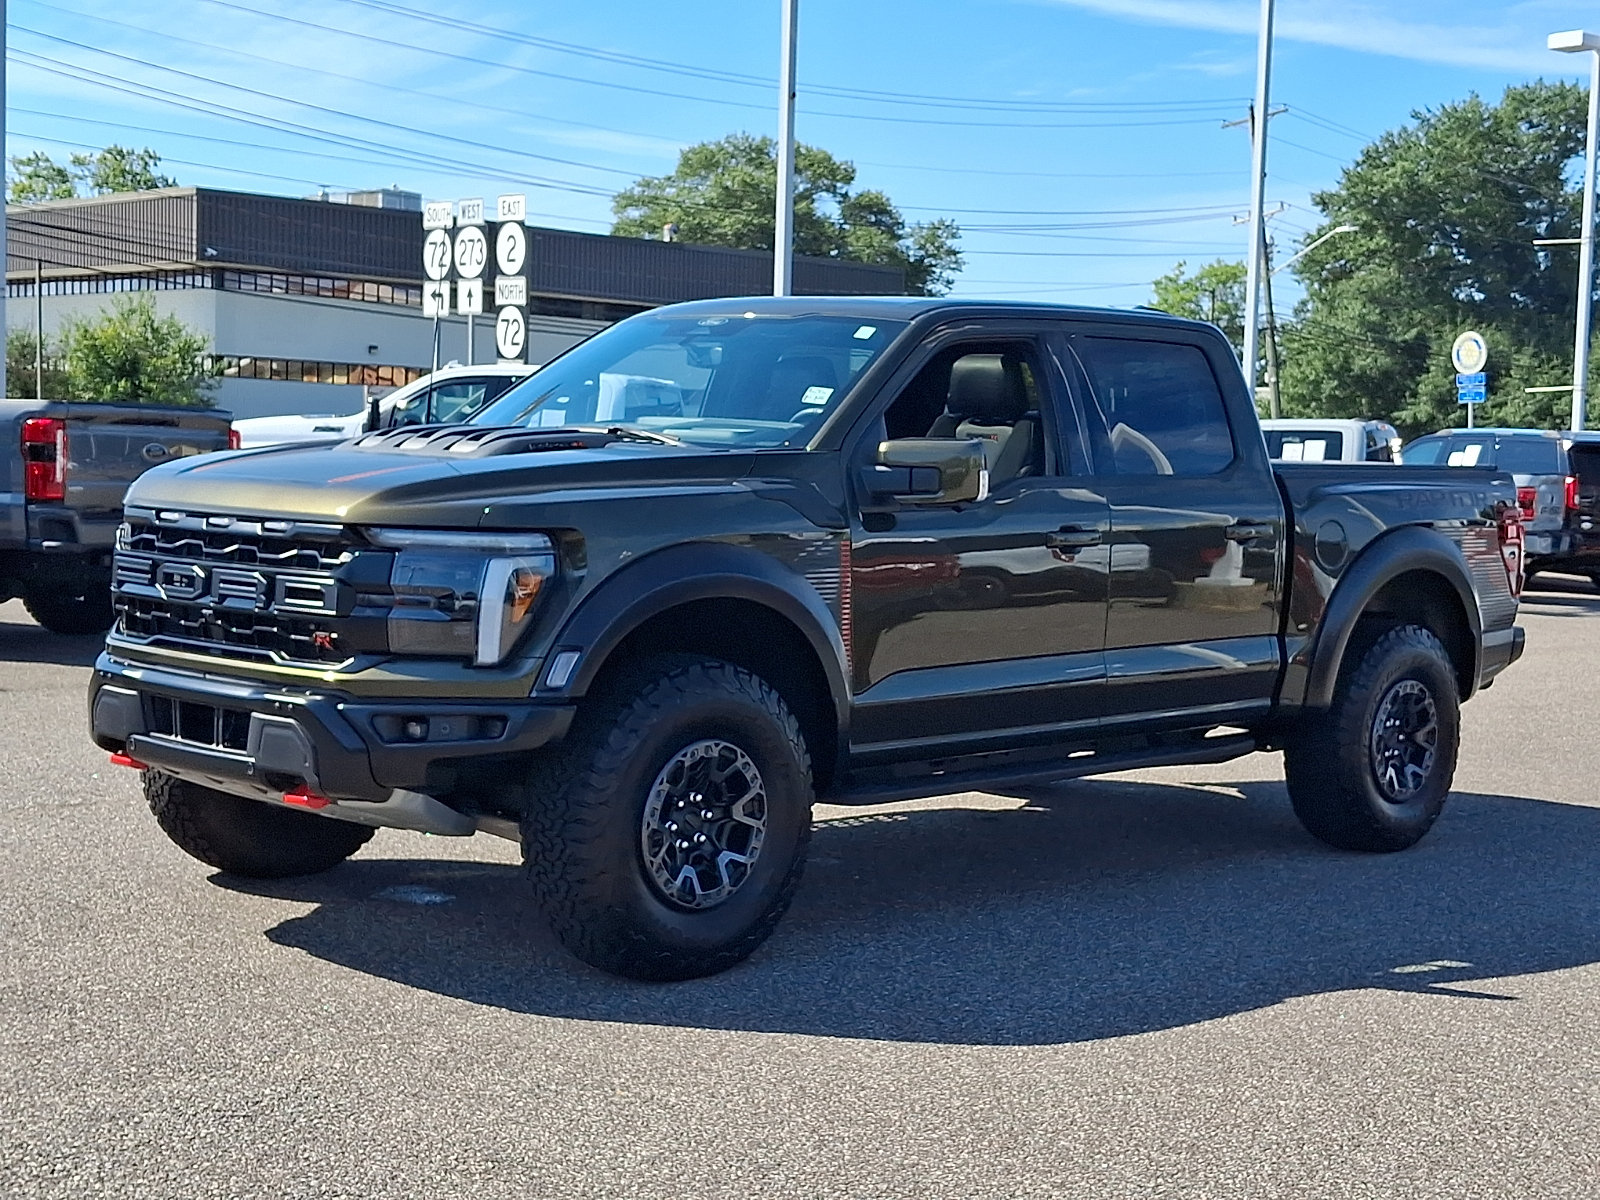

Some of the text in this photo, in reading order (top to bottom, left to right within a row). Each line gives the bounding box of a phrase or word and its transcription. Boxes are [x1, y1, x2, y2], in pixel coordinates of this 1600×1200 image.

[426, 208, 452, 223] SOUTH
[461, 203, 481, 220] WEST
[501, 200, 521, 216] EAST
[428, 241, 448, 268] 72
[458, 238, 484, 267] 273
[506, 235, 517, 263] 2
[498, 284, 525, 301] NORTH
[500, 318, 521, 346] 72
[112, 555, 338, 616] FORD
